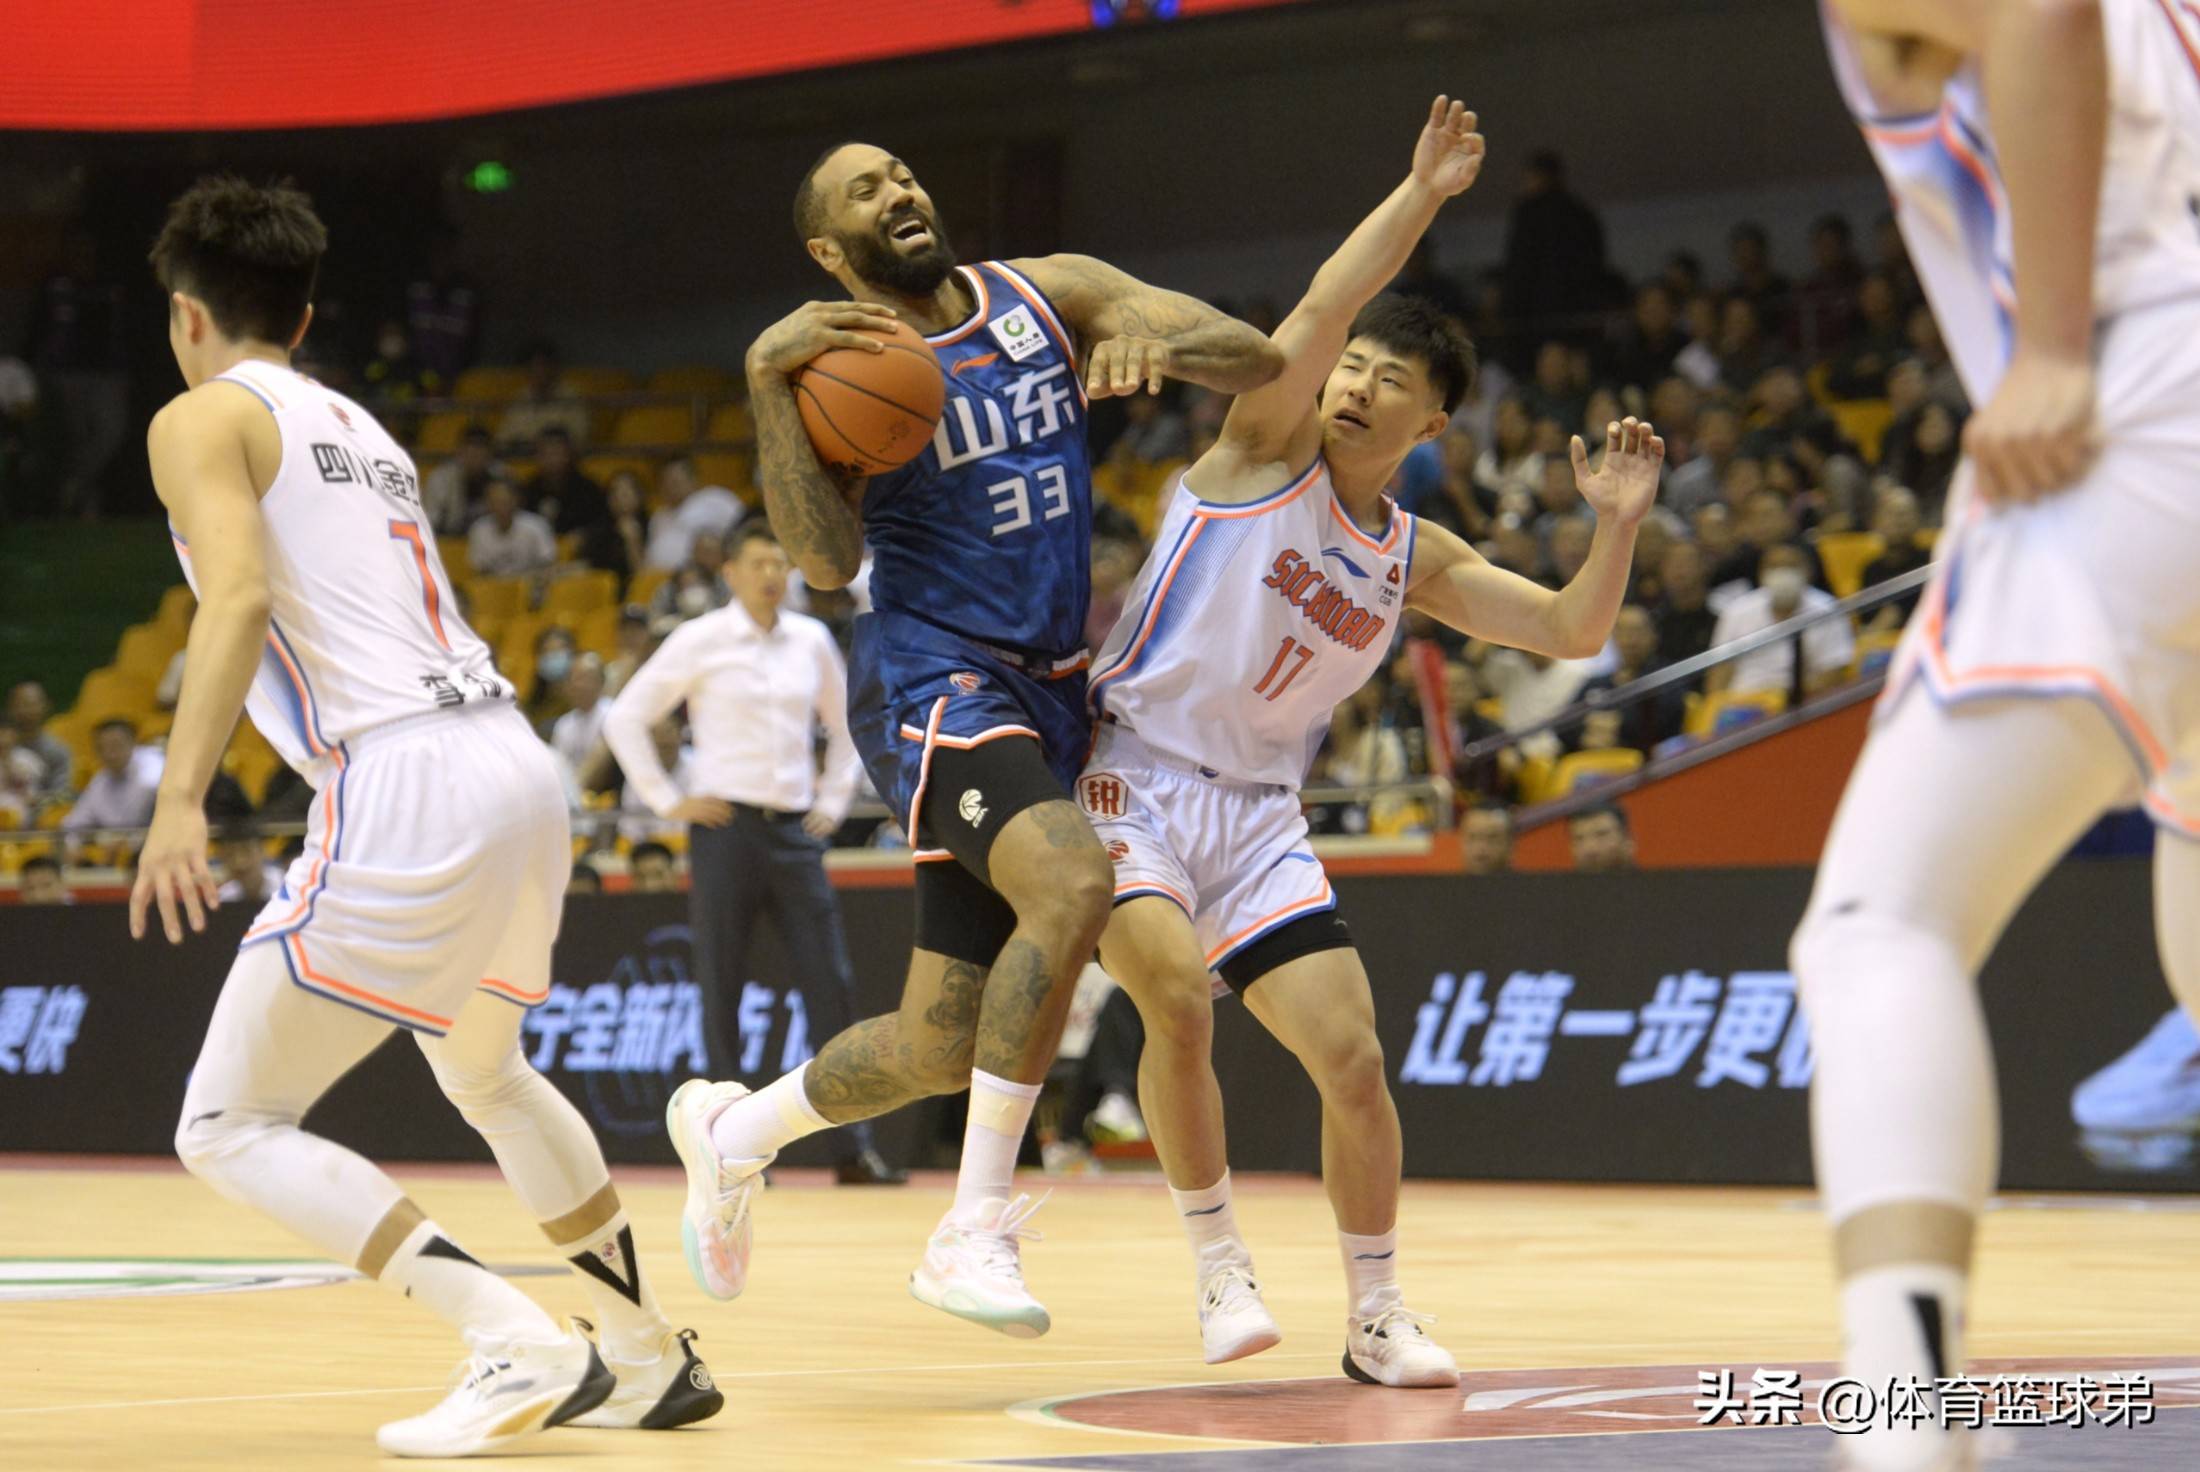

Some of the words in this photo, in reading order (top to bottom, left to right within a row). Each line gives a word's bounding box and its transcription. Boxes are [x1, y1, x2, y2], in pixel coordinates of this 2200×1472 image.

[932, 362, 1076, 473] 山东
[987, 463, 1071, 537] 33
[387, 518, 454, 653] 7
[1253, 635, 1315, 702] 17
